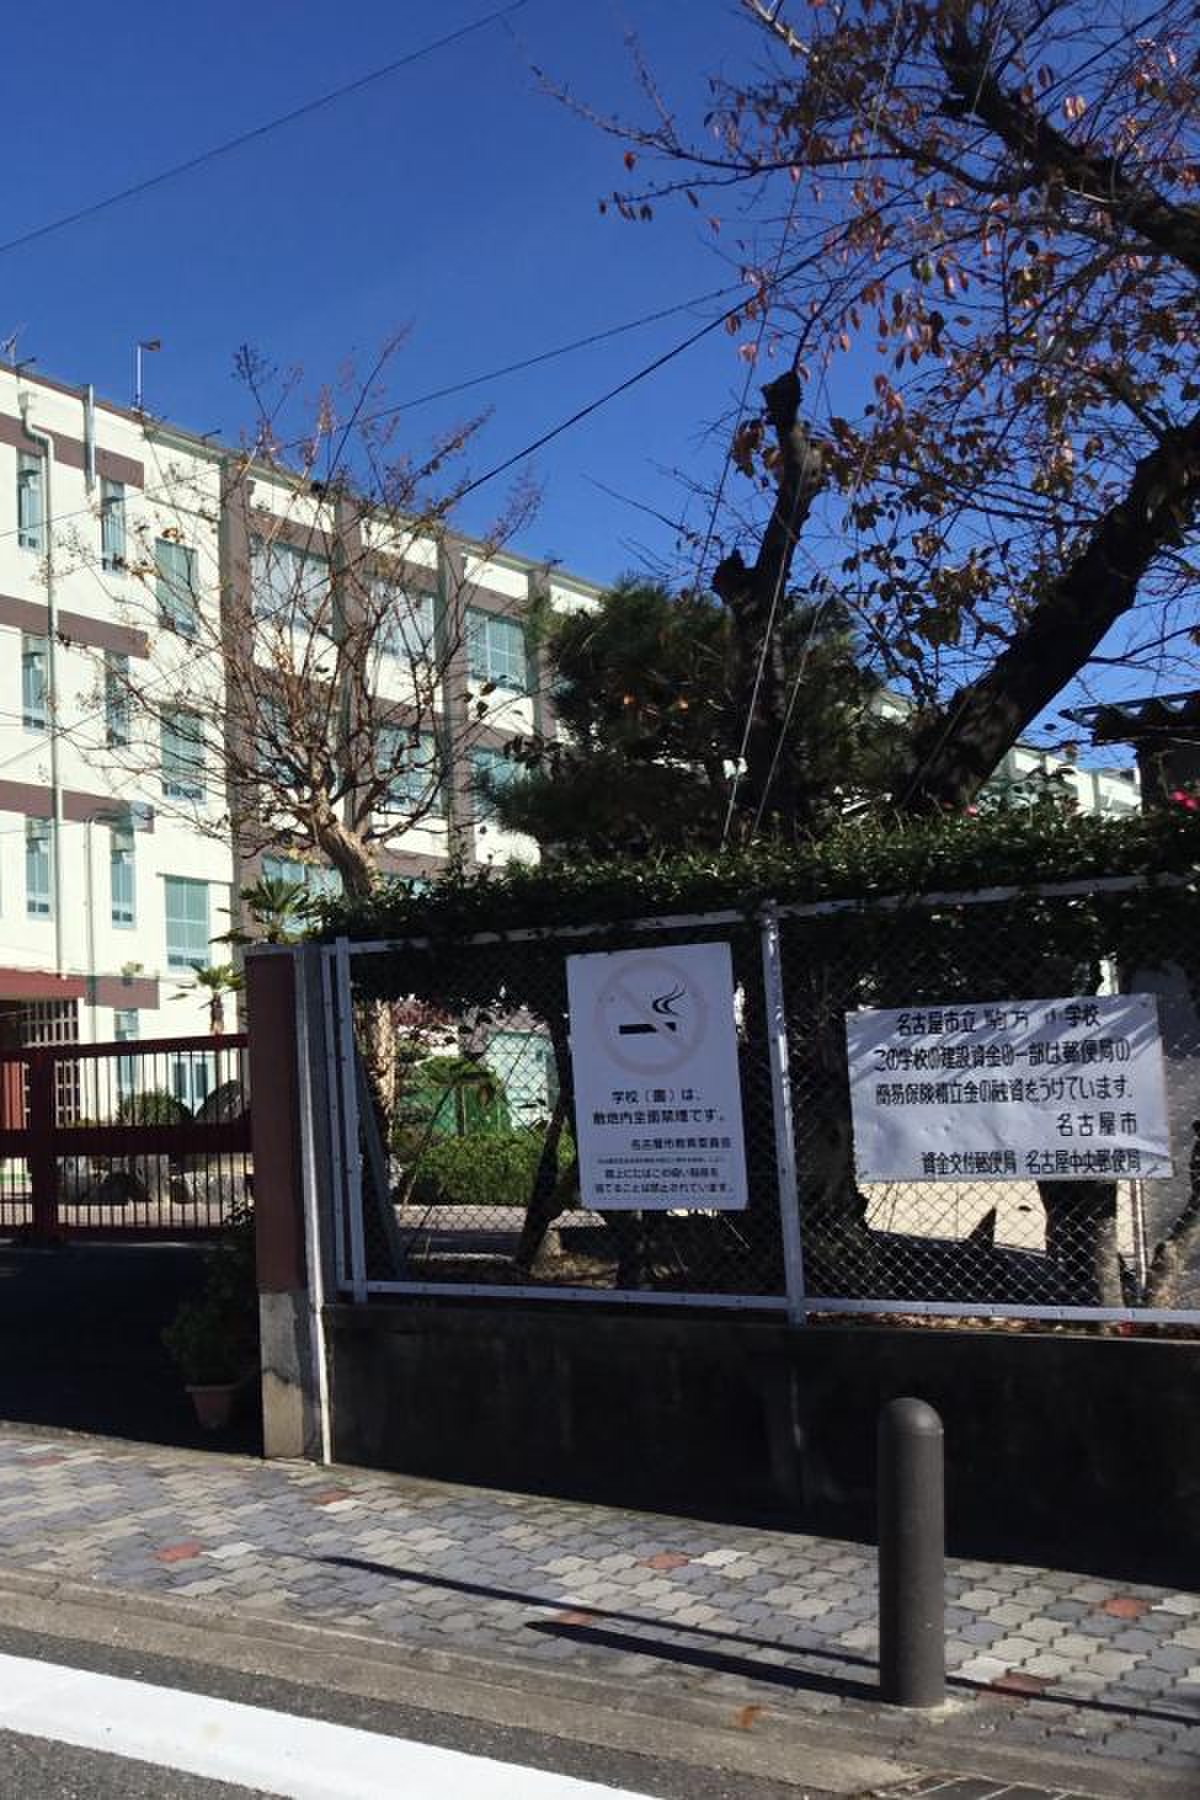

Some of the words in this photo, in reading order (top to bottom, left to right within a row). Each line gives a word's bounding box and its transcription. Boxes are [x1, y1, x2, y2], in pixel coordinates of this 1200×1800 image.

[896, 1010, 977, 1036] 名古屋市立
[1056, 1111, 1138, 1137] 名古屋市
[1025, 1149, 1141, 1175] 名古屋中央郵便局
